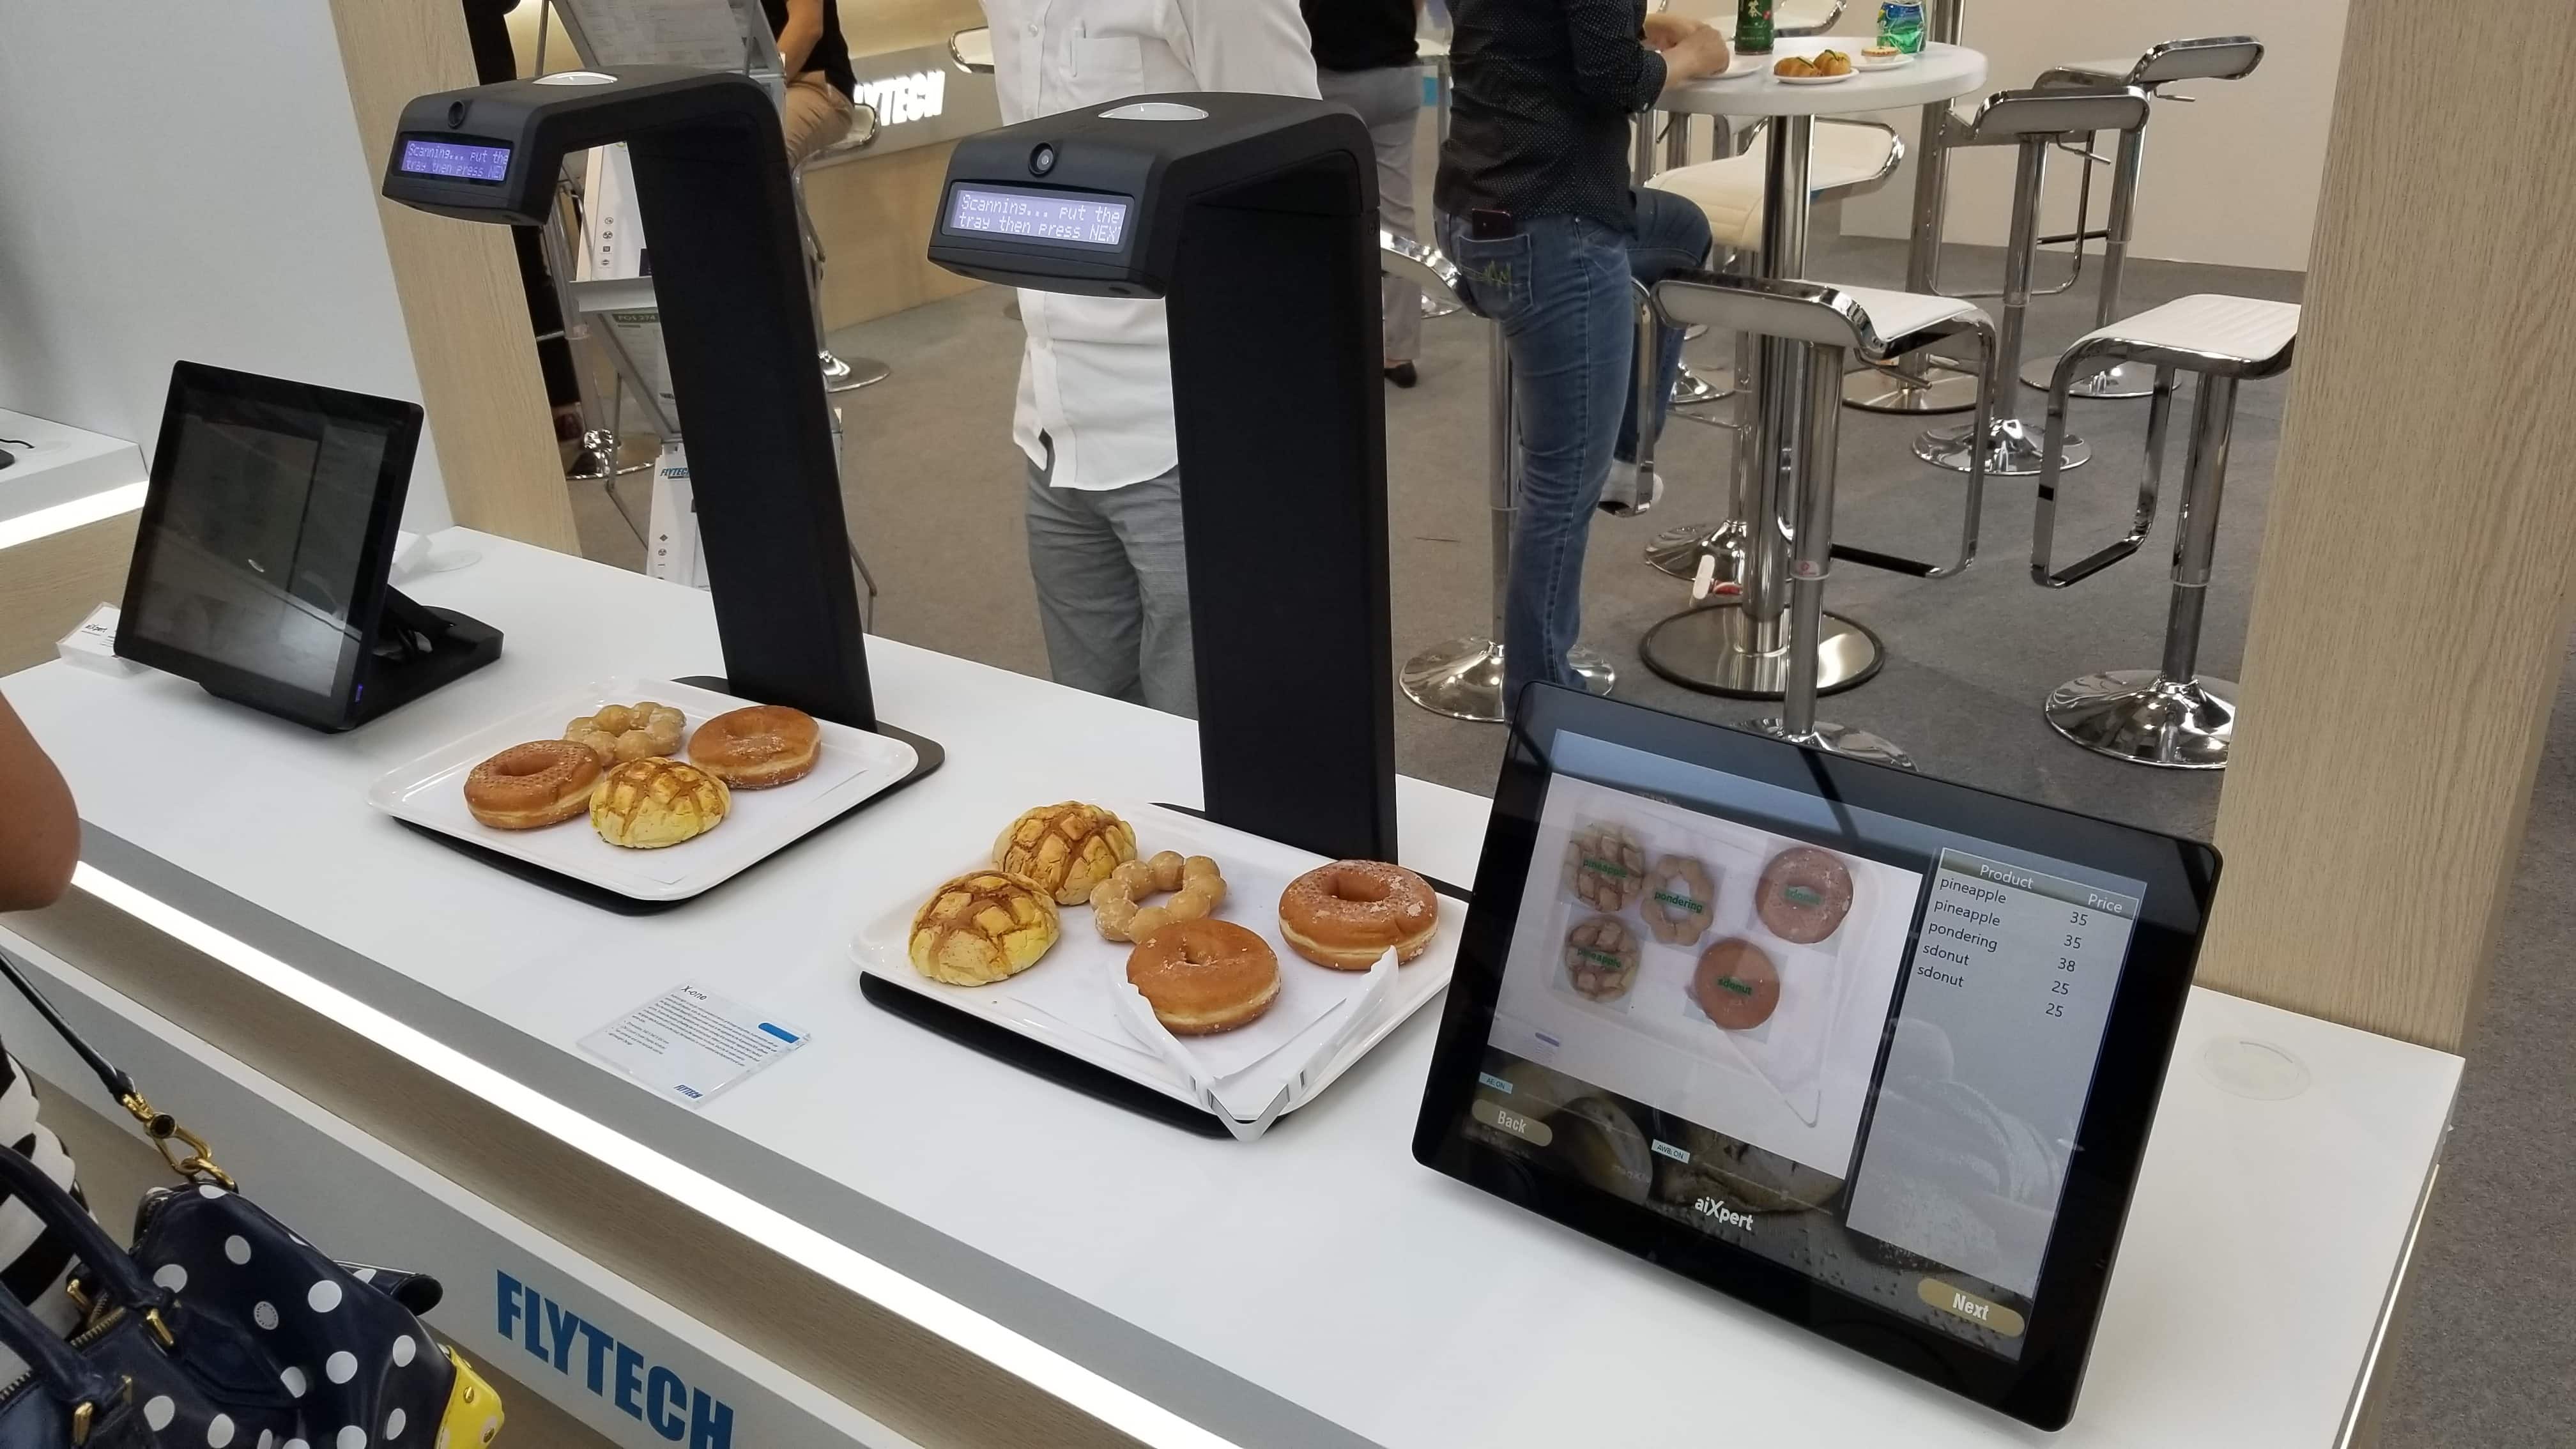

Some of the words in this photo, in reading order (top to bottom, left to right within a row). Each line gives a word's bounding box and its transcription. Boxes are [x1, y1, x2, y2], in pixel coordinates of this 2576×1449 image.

[958, 211, 991, 229] tray
[999, 216, 1031, 234] then
[1095, 205, 1121, 224] the
[1653, 890, 1703, 914] pondering
[1940, 877, 2007, 905] pineapple
[2070, 911, 2089, 926] 35
[1980, 864, 2034, 890] Product
[2088, 893, 2123, 914] Price
[1934, 900, 2000, 927] pineapple
[2064, 935, 2082, 950] 35
[1928, 921, 1998, 953] pondering
[2057, 957, 2076, 972] 38
[1922, 944, 1970, 967] sdonut
[2051, 980, 2070, 995] 25
[1917, 965, 1965, 988] sdonut
[2045, 1002, 2064, 1018] 25
[1498, 1110, 1527, 1134] Back
[1673, 1150, 1684, 1160] ON
[1694, 1196, 1755, 1232] aiXpert
[1952, 1292, 1989, 1321] Next
[496, 1269, 734, 1449] FLYTECH
